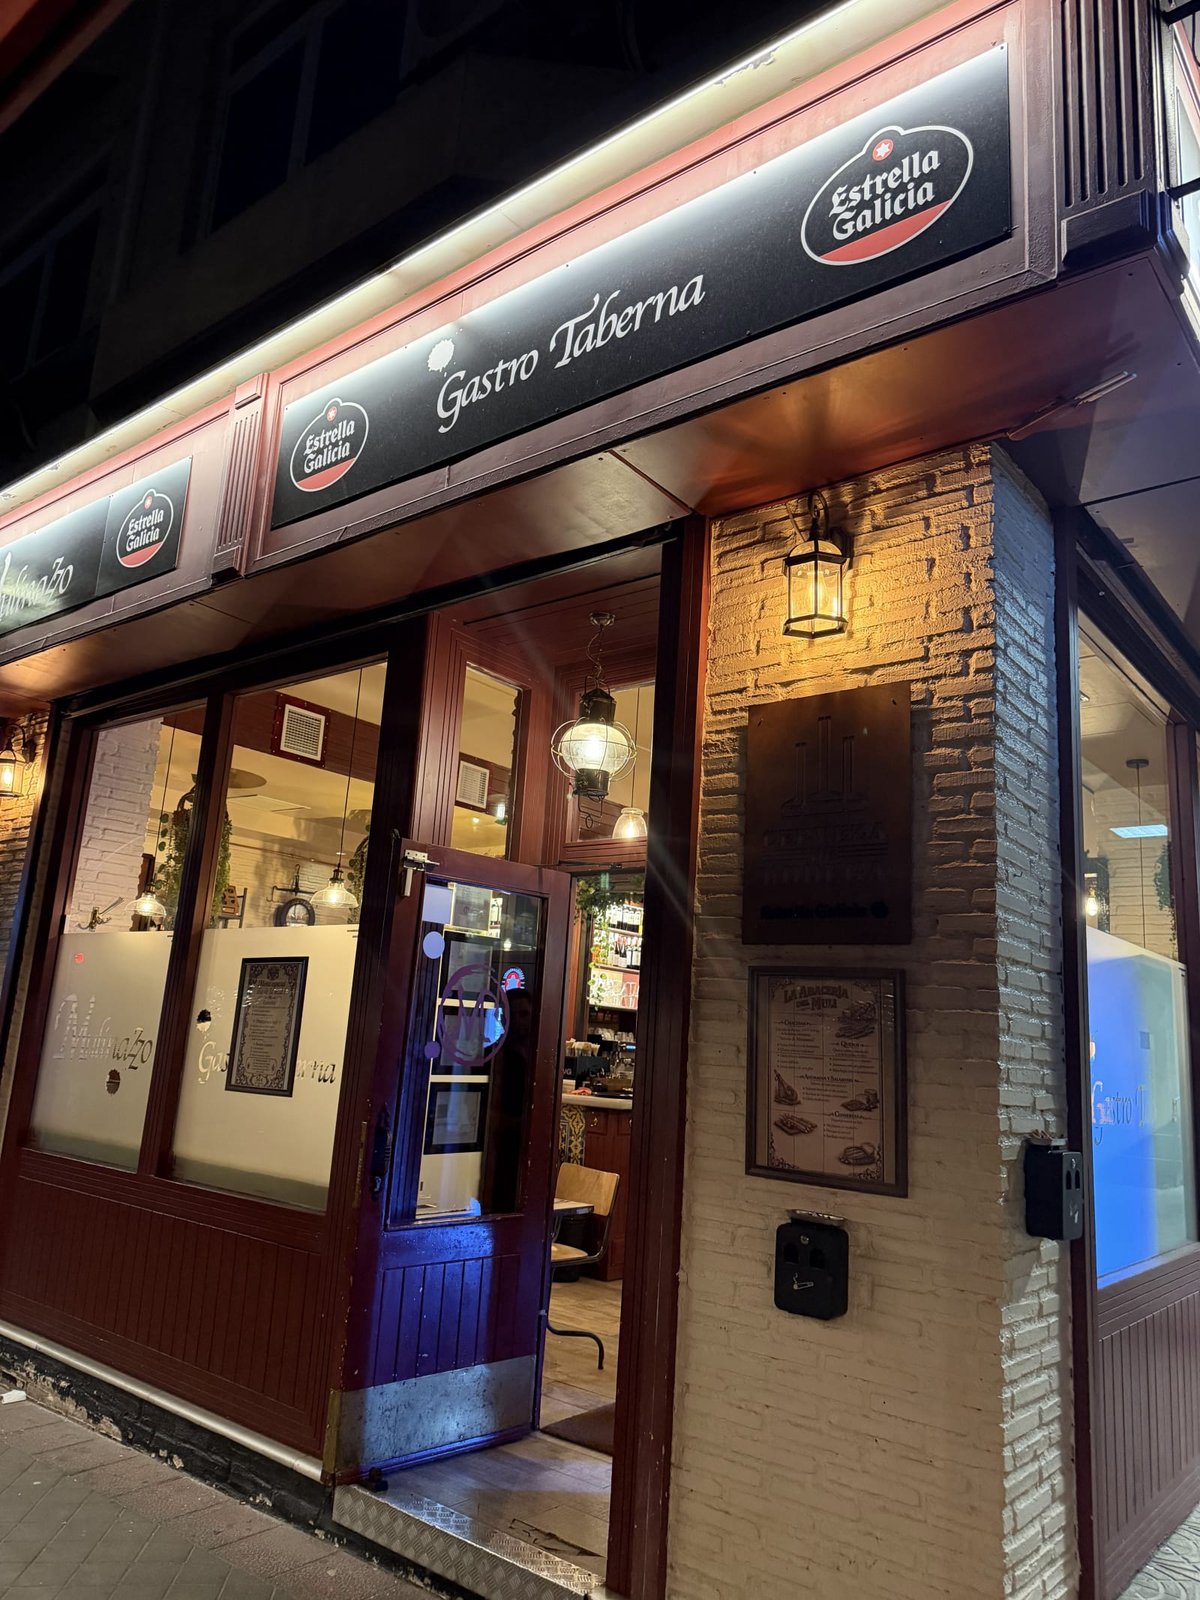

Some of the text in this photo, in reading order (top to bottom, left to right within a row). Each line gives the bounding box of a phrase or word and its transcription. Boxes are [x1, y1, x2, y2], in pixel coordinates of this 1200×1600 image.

[829, 150, 941, 217] Estrella
[833, 181, 936, 241] Galicia
[436, 274, 706, 434] Gastro Taberna
[303, 420, 355, 455] Estrella
[304, 441, 350, 473] Galicia
[126, 526, 160, 552] Galicia
[127, 509, 164, 536] Estrella
